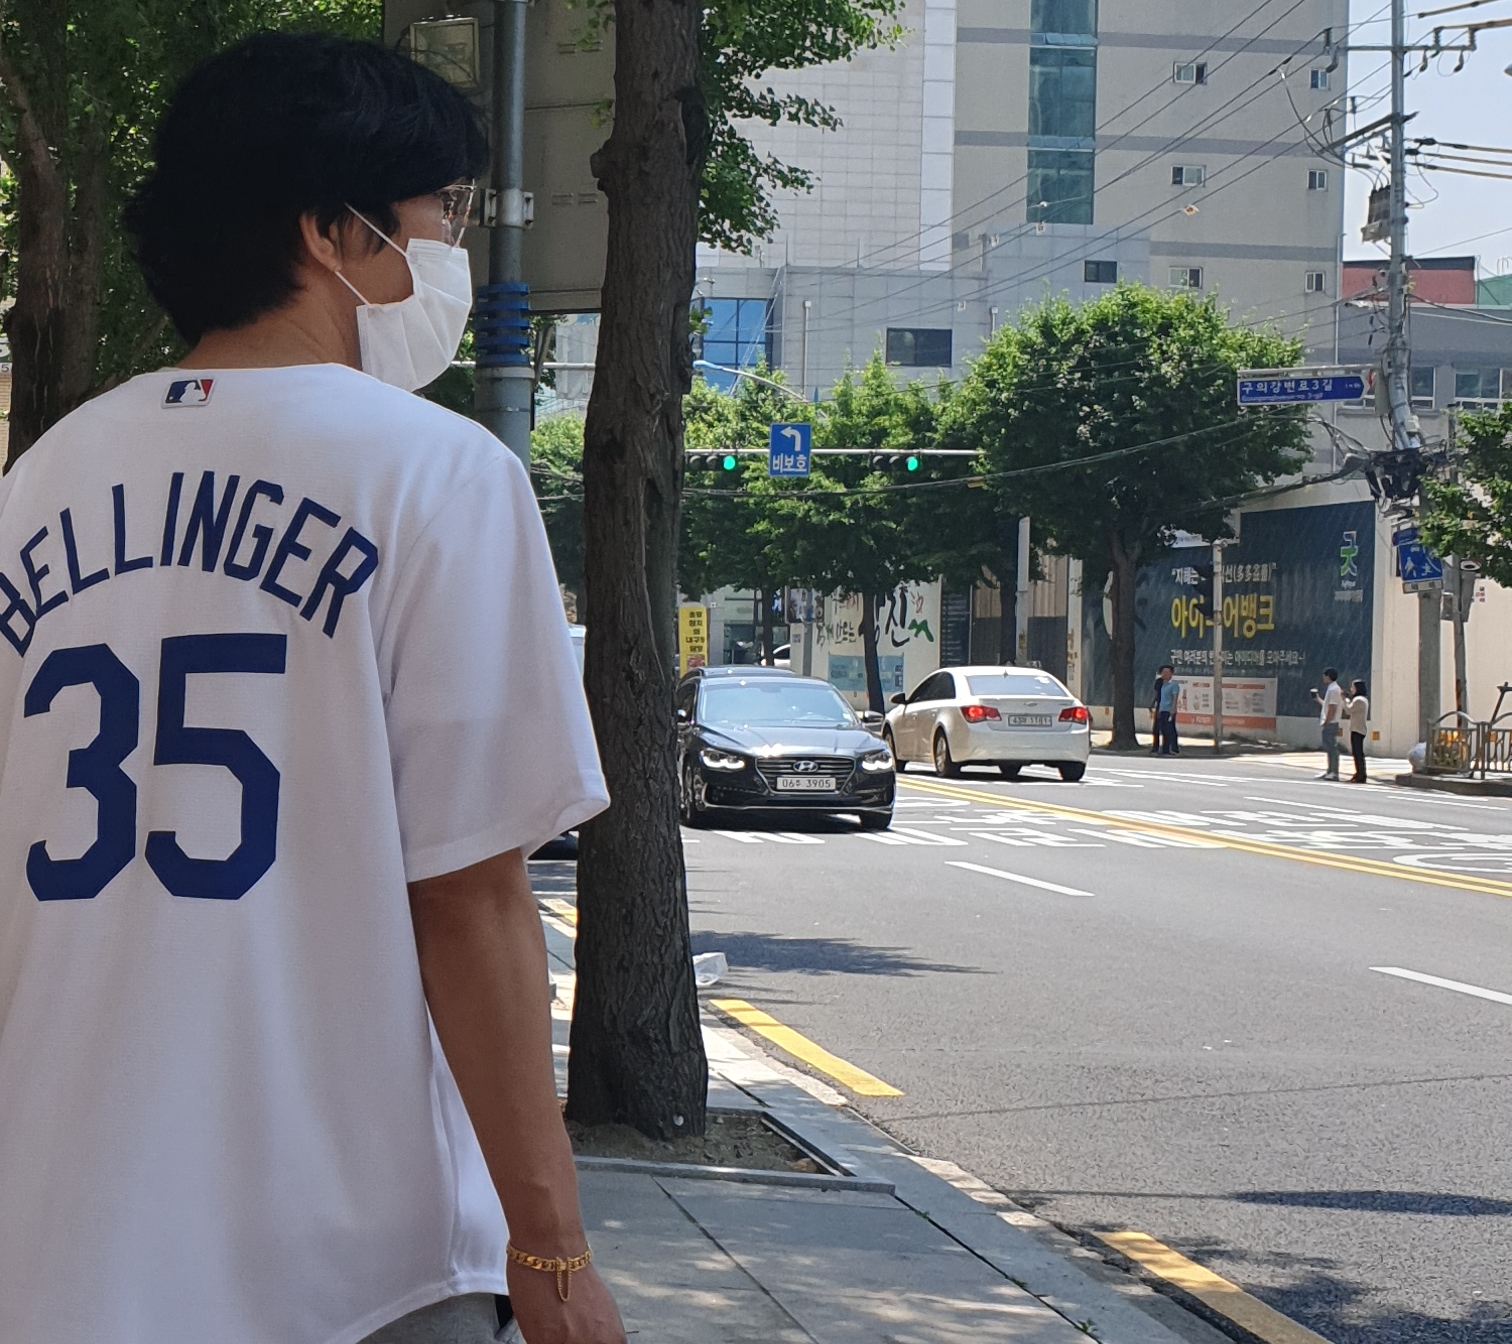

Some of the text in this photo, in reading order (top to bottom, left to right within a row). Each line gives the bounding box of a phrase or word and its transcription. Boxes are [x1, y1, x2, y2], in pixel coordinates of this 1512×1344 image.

[1241, 379, 1333, 394] 구의강변로3길
[772, 452, 807, 474] 비보호
[1171, 592, 1275, 639] 아이어뱅크
[23, 632, 288, 902] 35
[806, 779, 831, 788] 3905
